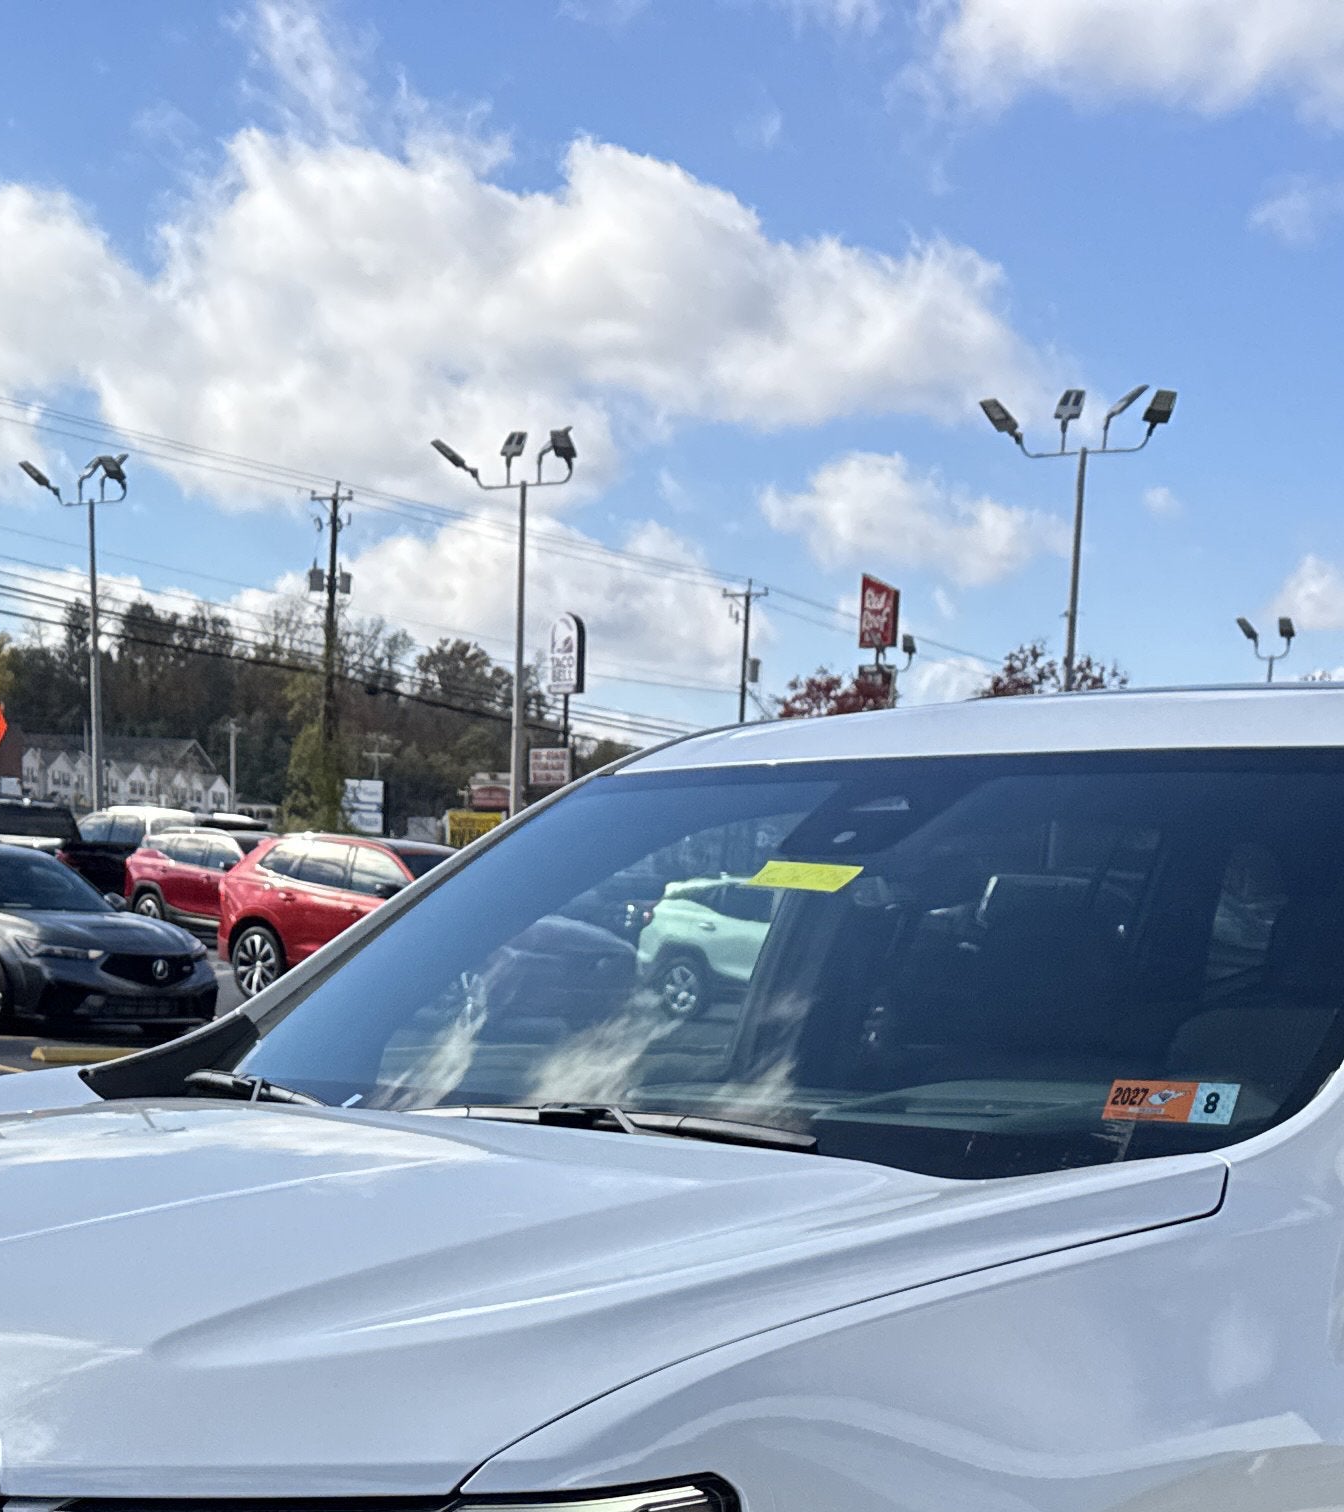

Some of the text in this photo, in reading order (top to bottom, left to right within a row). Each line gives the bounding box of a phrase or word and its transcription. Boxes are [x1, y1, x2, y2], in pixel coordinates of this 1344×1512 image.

[551, 655, 575, 668] TACO
[552, 668, 574, 682] BELL
[1110, 1087, 1221, 1114] 2027 8
